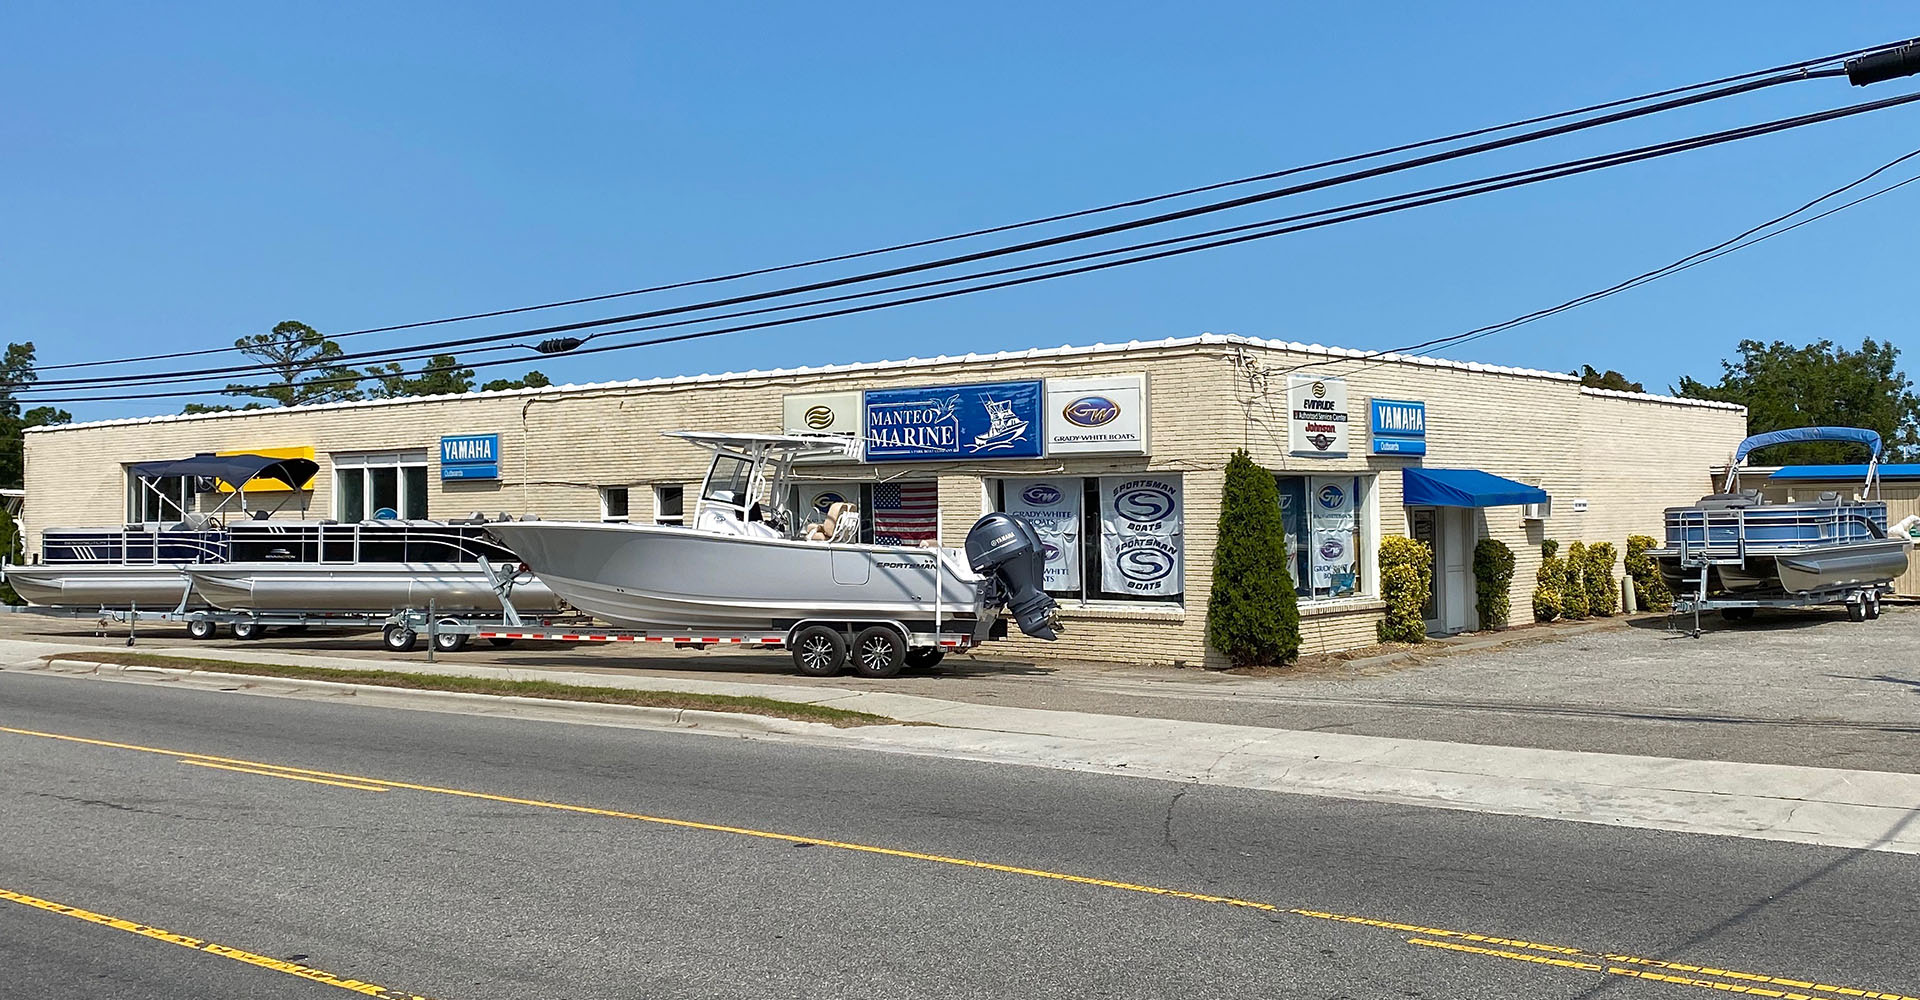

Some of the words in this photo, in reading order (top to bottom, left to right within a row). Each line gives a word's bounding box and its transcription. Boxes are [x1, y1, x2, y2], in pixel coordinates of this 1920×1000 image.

[1304, 399, 1335, 411] EVINRUDE
[871, 409, 933, 426] MANTEO
[1378, 405, 1423, 431] YAMAHA
[1305, 422, 1336, 433] Johnson
[871, 425, 954, 448] MARINE
[1108, 433, 1135, 441] BOATS
[443, 440, 491, 460] YAMAHA
[1113, 480, 1176, 497] SPORTSMAN
[1127, 522, 1162, 532] BOATS
[1115, 539, 1178, 555] SPORTSMAN
[876, 562, 937, 570] SPORTSMAN
[1127, 581, 1161, 591] BOATS
